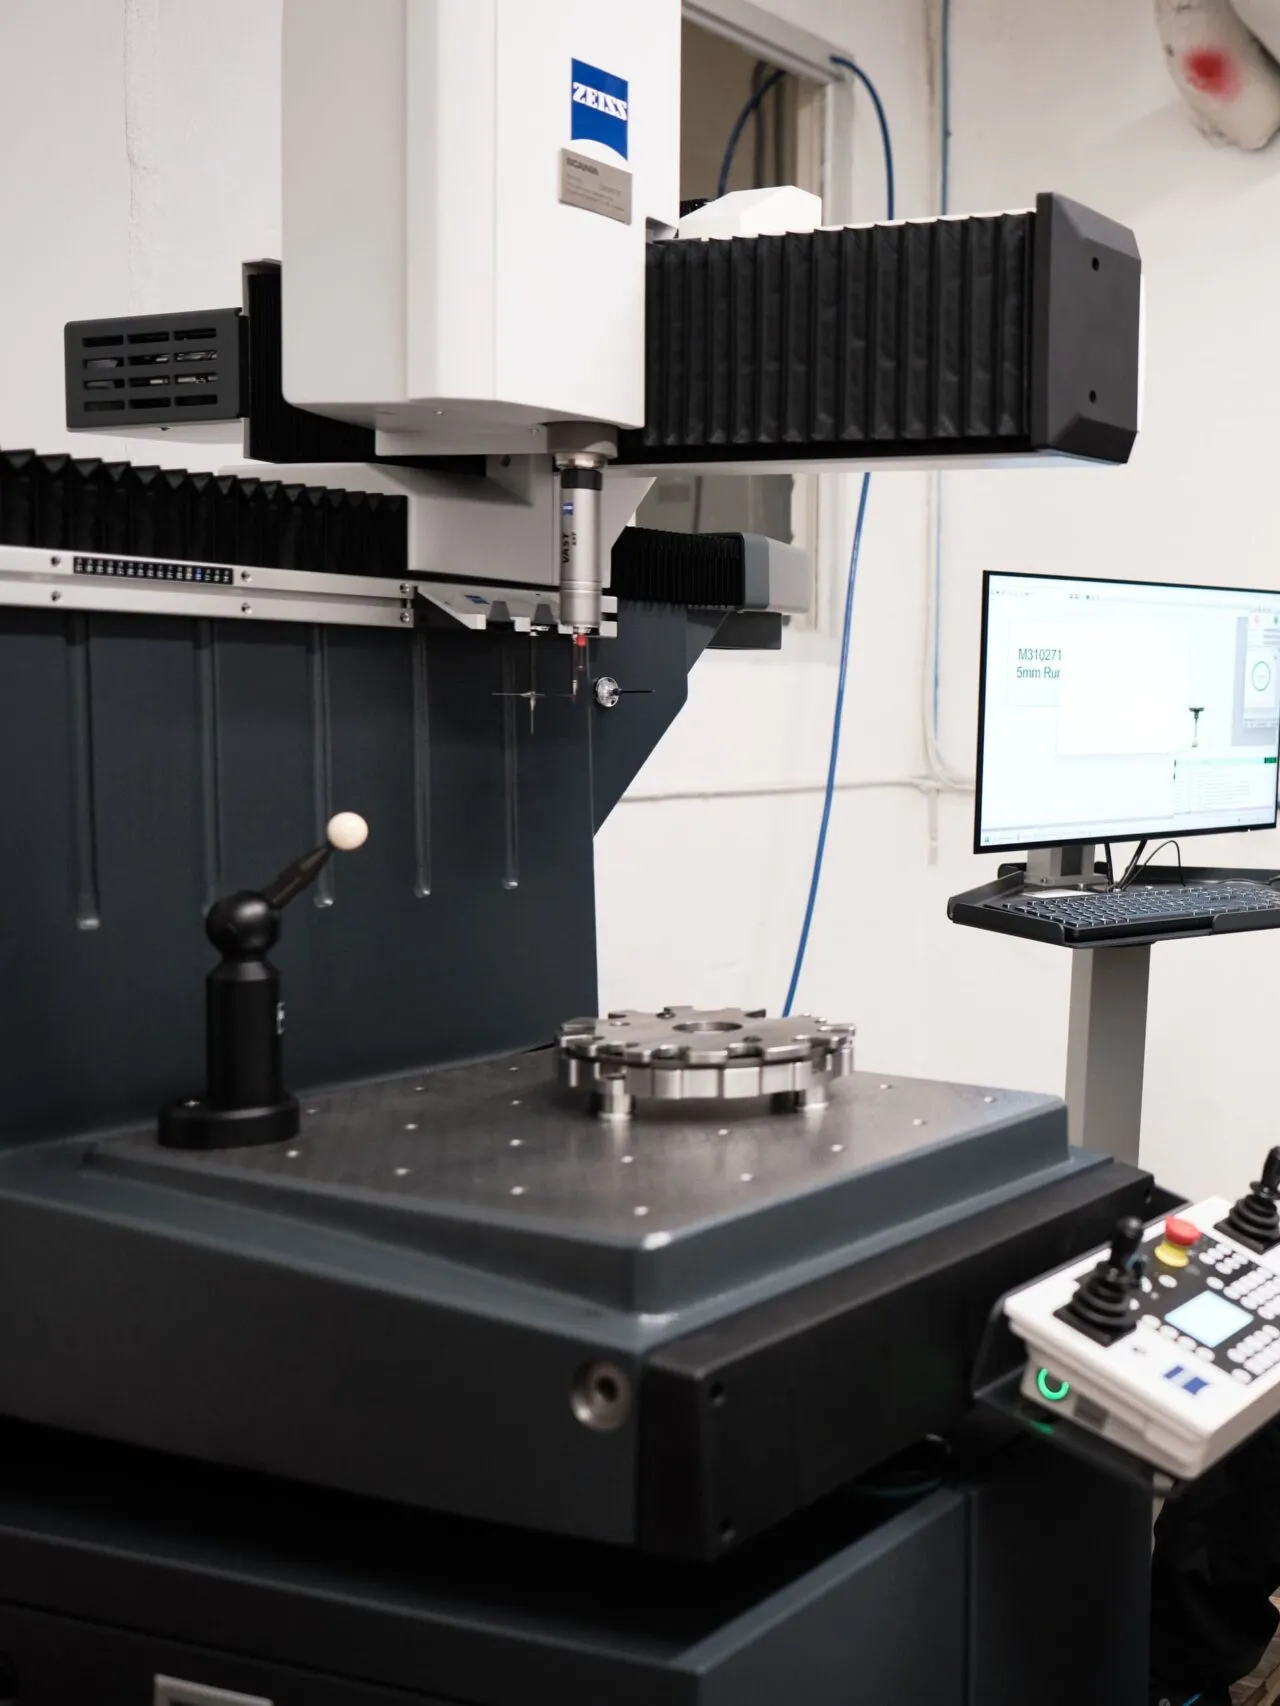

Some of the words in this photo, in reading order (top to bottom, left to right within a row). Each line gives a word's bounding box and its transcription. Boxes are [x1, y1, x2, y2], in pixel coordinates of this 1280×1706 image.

[572, 81, 627, 121] ZEISS
[561, 533, 570, 564] VAST
[1018, 648, 1062, 661] M310271
[1016, 666, 1041, 679] 5mm
